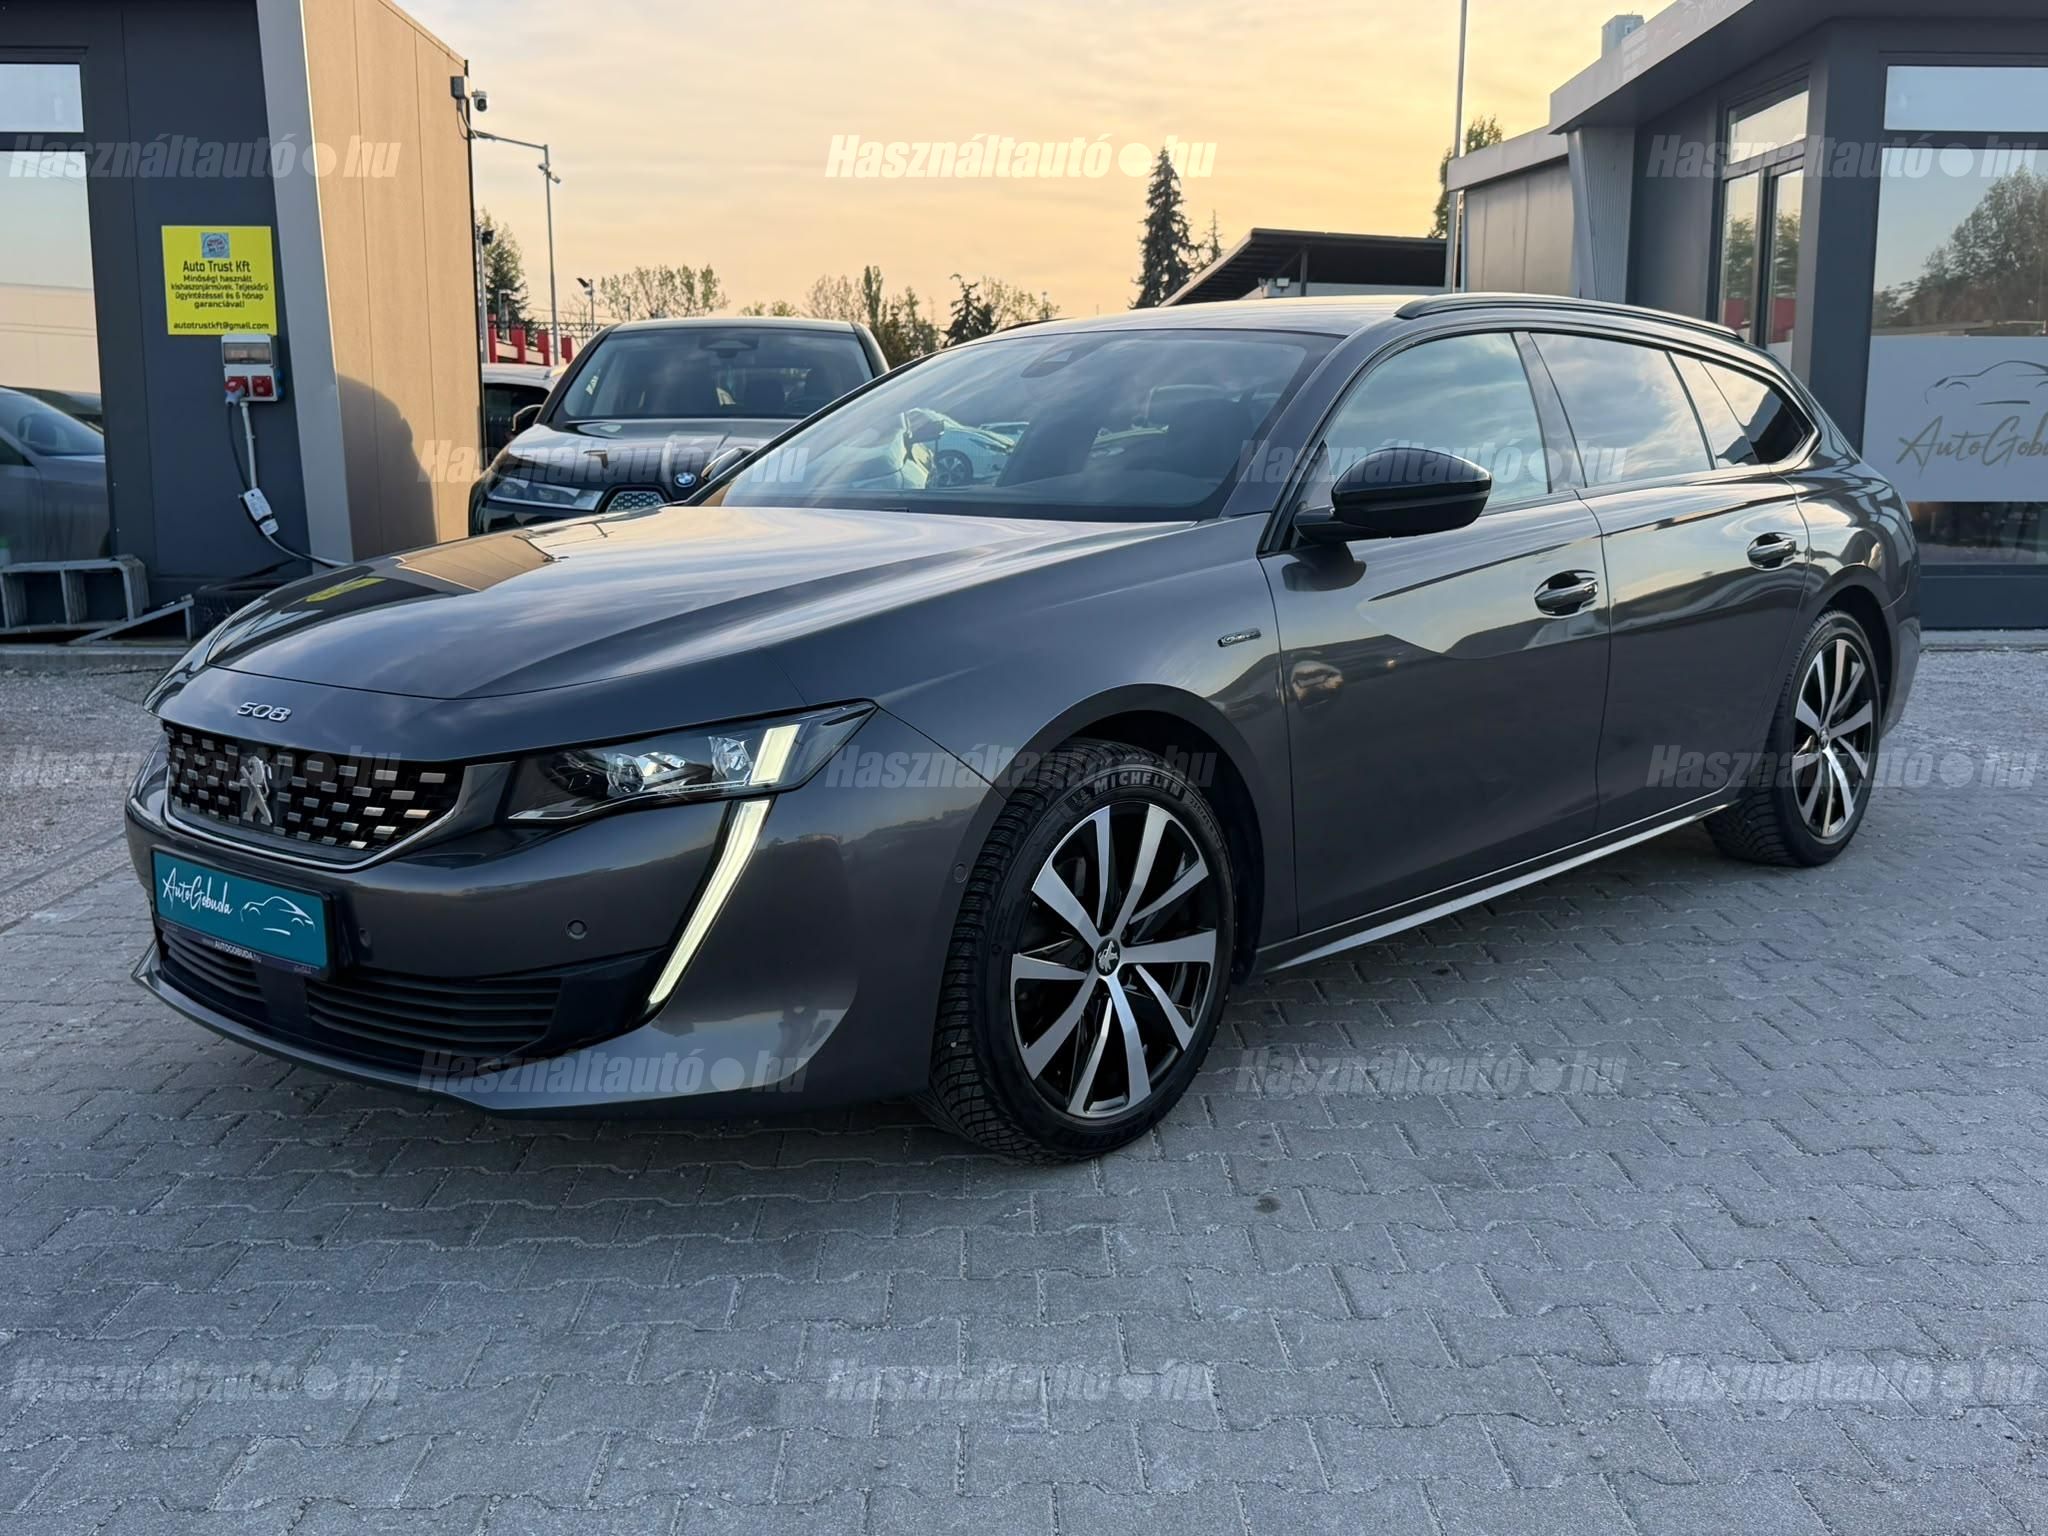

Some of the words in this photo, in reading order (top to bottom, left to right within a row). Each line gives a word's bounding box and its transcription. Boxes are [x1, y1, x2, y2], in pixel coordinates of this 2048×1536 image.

[183, 260, 205, 272] Auto
[208, 260, 233, 272] Trust
[236, 260, 251, 272] Kft
[242, 292, 263, 300] hónap
[173, 322, 269, 330] autotrustkft@gmail.com
[237, 702, 292, 722] 508
[1094, 771, 1181, 796] MICHELIN
[162, 867, 234, 916] AutoGobuda
